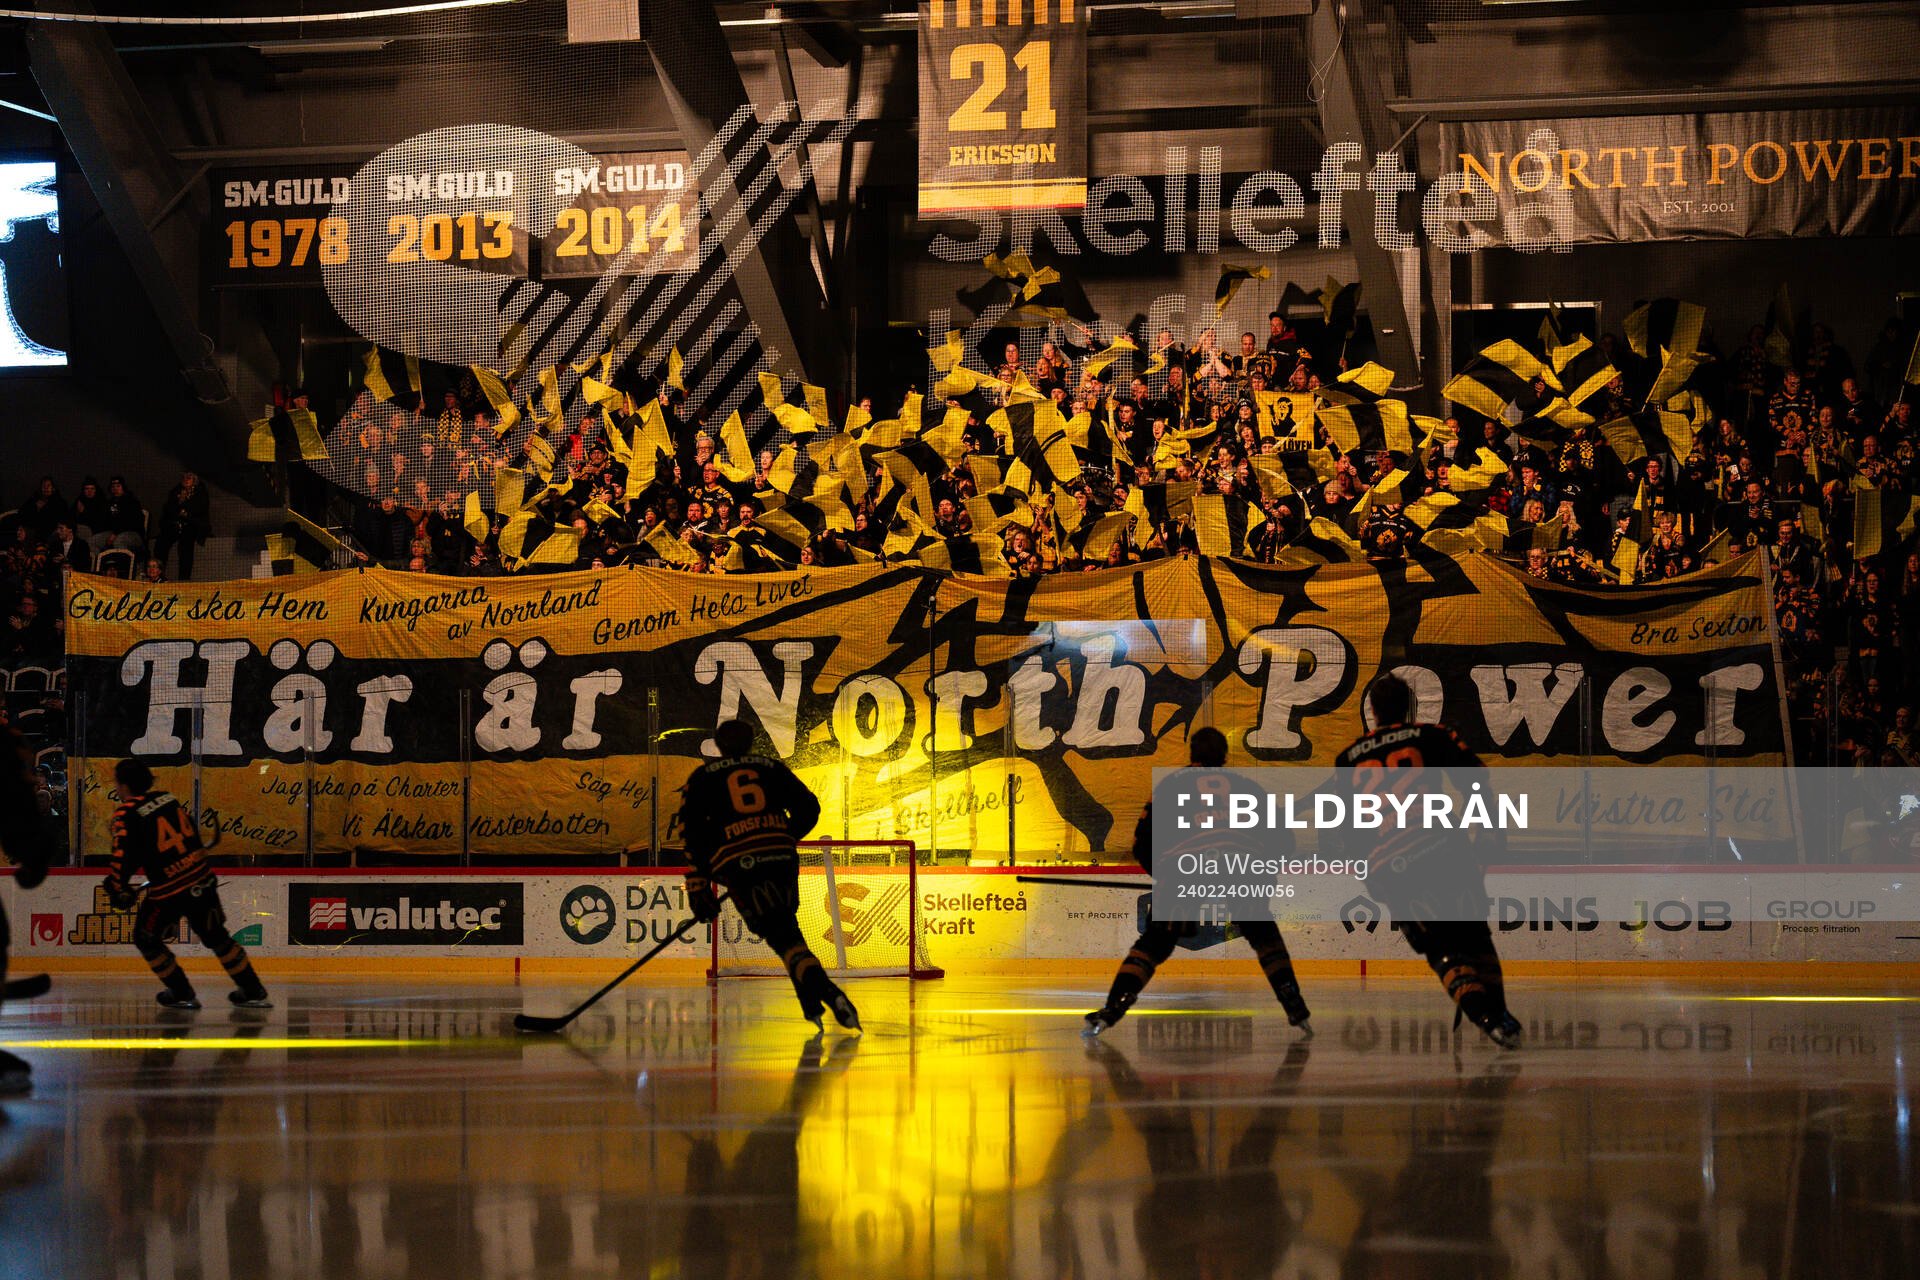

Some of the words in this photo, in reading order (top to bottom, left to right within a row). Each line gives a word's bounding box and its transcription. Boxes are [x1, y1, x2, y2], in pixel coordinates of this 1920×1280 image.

[948, 41, 1056, 131] 21
[949, 143, 1056, 166] ERICSSON
[1458, 146, 1689, 196] NORTH
[1706, 136, 1920, 186] POWER
[224, 177, 350, 208] SM-GULD
[386, 170, 514, 202] SM-GULD
[555, 162, 684, 195] SM-GULD
[1663, 201, 1697, 214] EST.
[1701, 201, 1735, 214] 2001
[225, 217, 350, 268] 1978
[387, 210, 514, 264] 2013
[556, 203, 685, 257] 2014
[69, 588, 177, 622] Guldet
[187, 591, 245, 622] ska
[257, 591, 329, 622] Hem
[359, 585, 490, 632] Kungarna
[447, 619, 474, 641] av
[481, 578, 602, 630] Norrland
[593, 610, 680, 646] Genom
[689, 594, 748, 624] Hela
[755, 573, 814, 607] Livet
[1630, 622, 1679, 645] Bra
[121, 638, 413, 756] Här
[475, 639, 623, 752] är
[695, 633, 1147, 758] North
[1238, 626, 1764, 752] Power
[260, 775, 303, 806] Jag
[313, 776, 344, 796] ska
[348, 778, 379, 801] på
[385, 775, 463, 797] Charter
[575, 771, 613, 803] Säg
[619, 779, 649, 809] Hej
[726, 767, 767, 814] 6
[342, 814, 363, 838] Vi
[371, 808, 454, 840] Älskar
[626, 885, 687, 911] DAT
[923, 891, 1027, 912] Skellefteå
[1766, 900, 1876, 919] GROUP
[924, 917, 975, 935] Kraft
[1088, 911, 1129, 919] PROJEKT
[1619, 900, 1733, 932] JOB
[1782, 924, 1819, 934] Process
